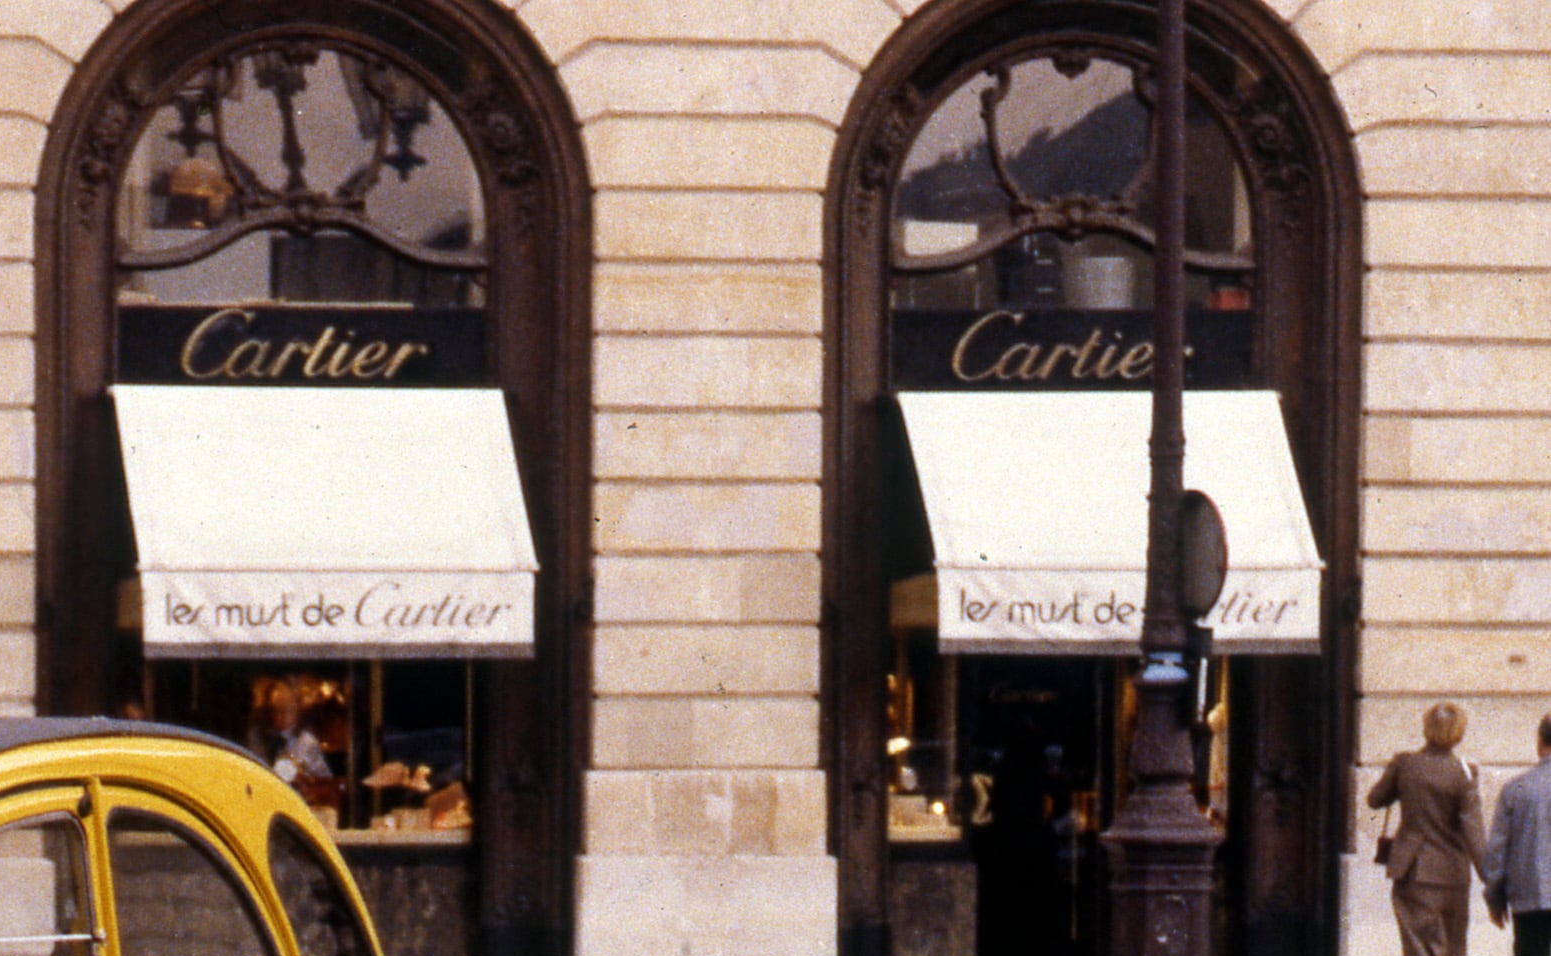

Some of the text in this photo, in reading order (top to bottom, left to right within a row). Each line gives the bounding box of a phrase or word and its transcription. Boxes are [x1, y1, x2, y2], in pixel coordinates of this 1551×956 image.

[180, 307, 429, 379] Cartier
[951, 310, 1194, 382] Cartie
[165, 579, 512, 627] les must de Cartier
[960, 587, 1000, 623] les
[1008, 590, 1082, 624] must
[1093, 589, 1136, 624] de
